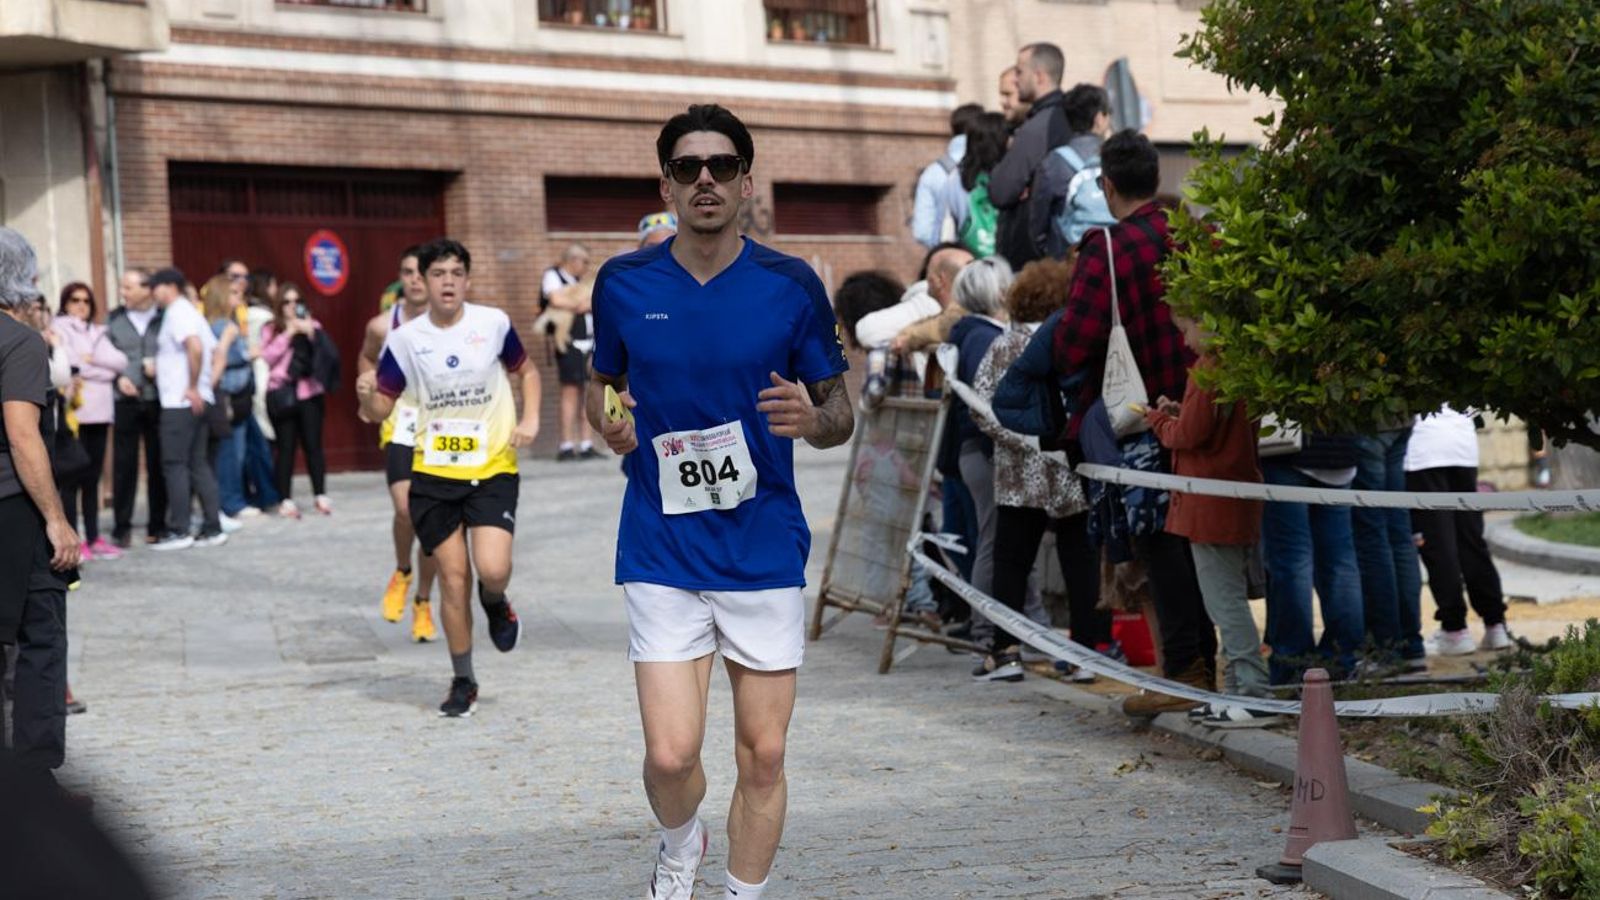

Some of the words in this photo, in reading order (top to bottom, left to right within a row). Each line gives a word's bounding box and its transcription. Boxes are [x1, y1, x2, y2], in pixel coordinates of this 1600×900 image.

[645, 312, 669, 320] KIPSTA
[437, 436, 475, 451] 383
[678, 455, 740, 488] 804
